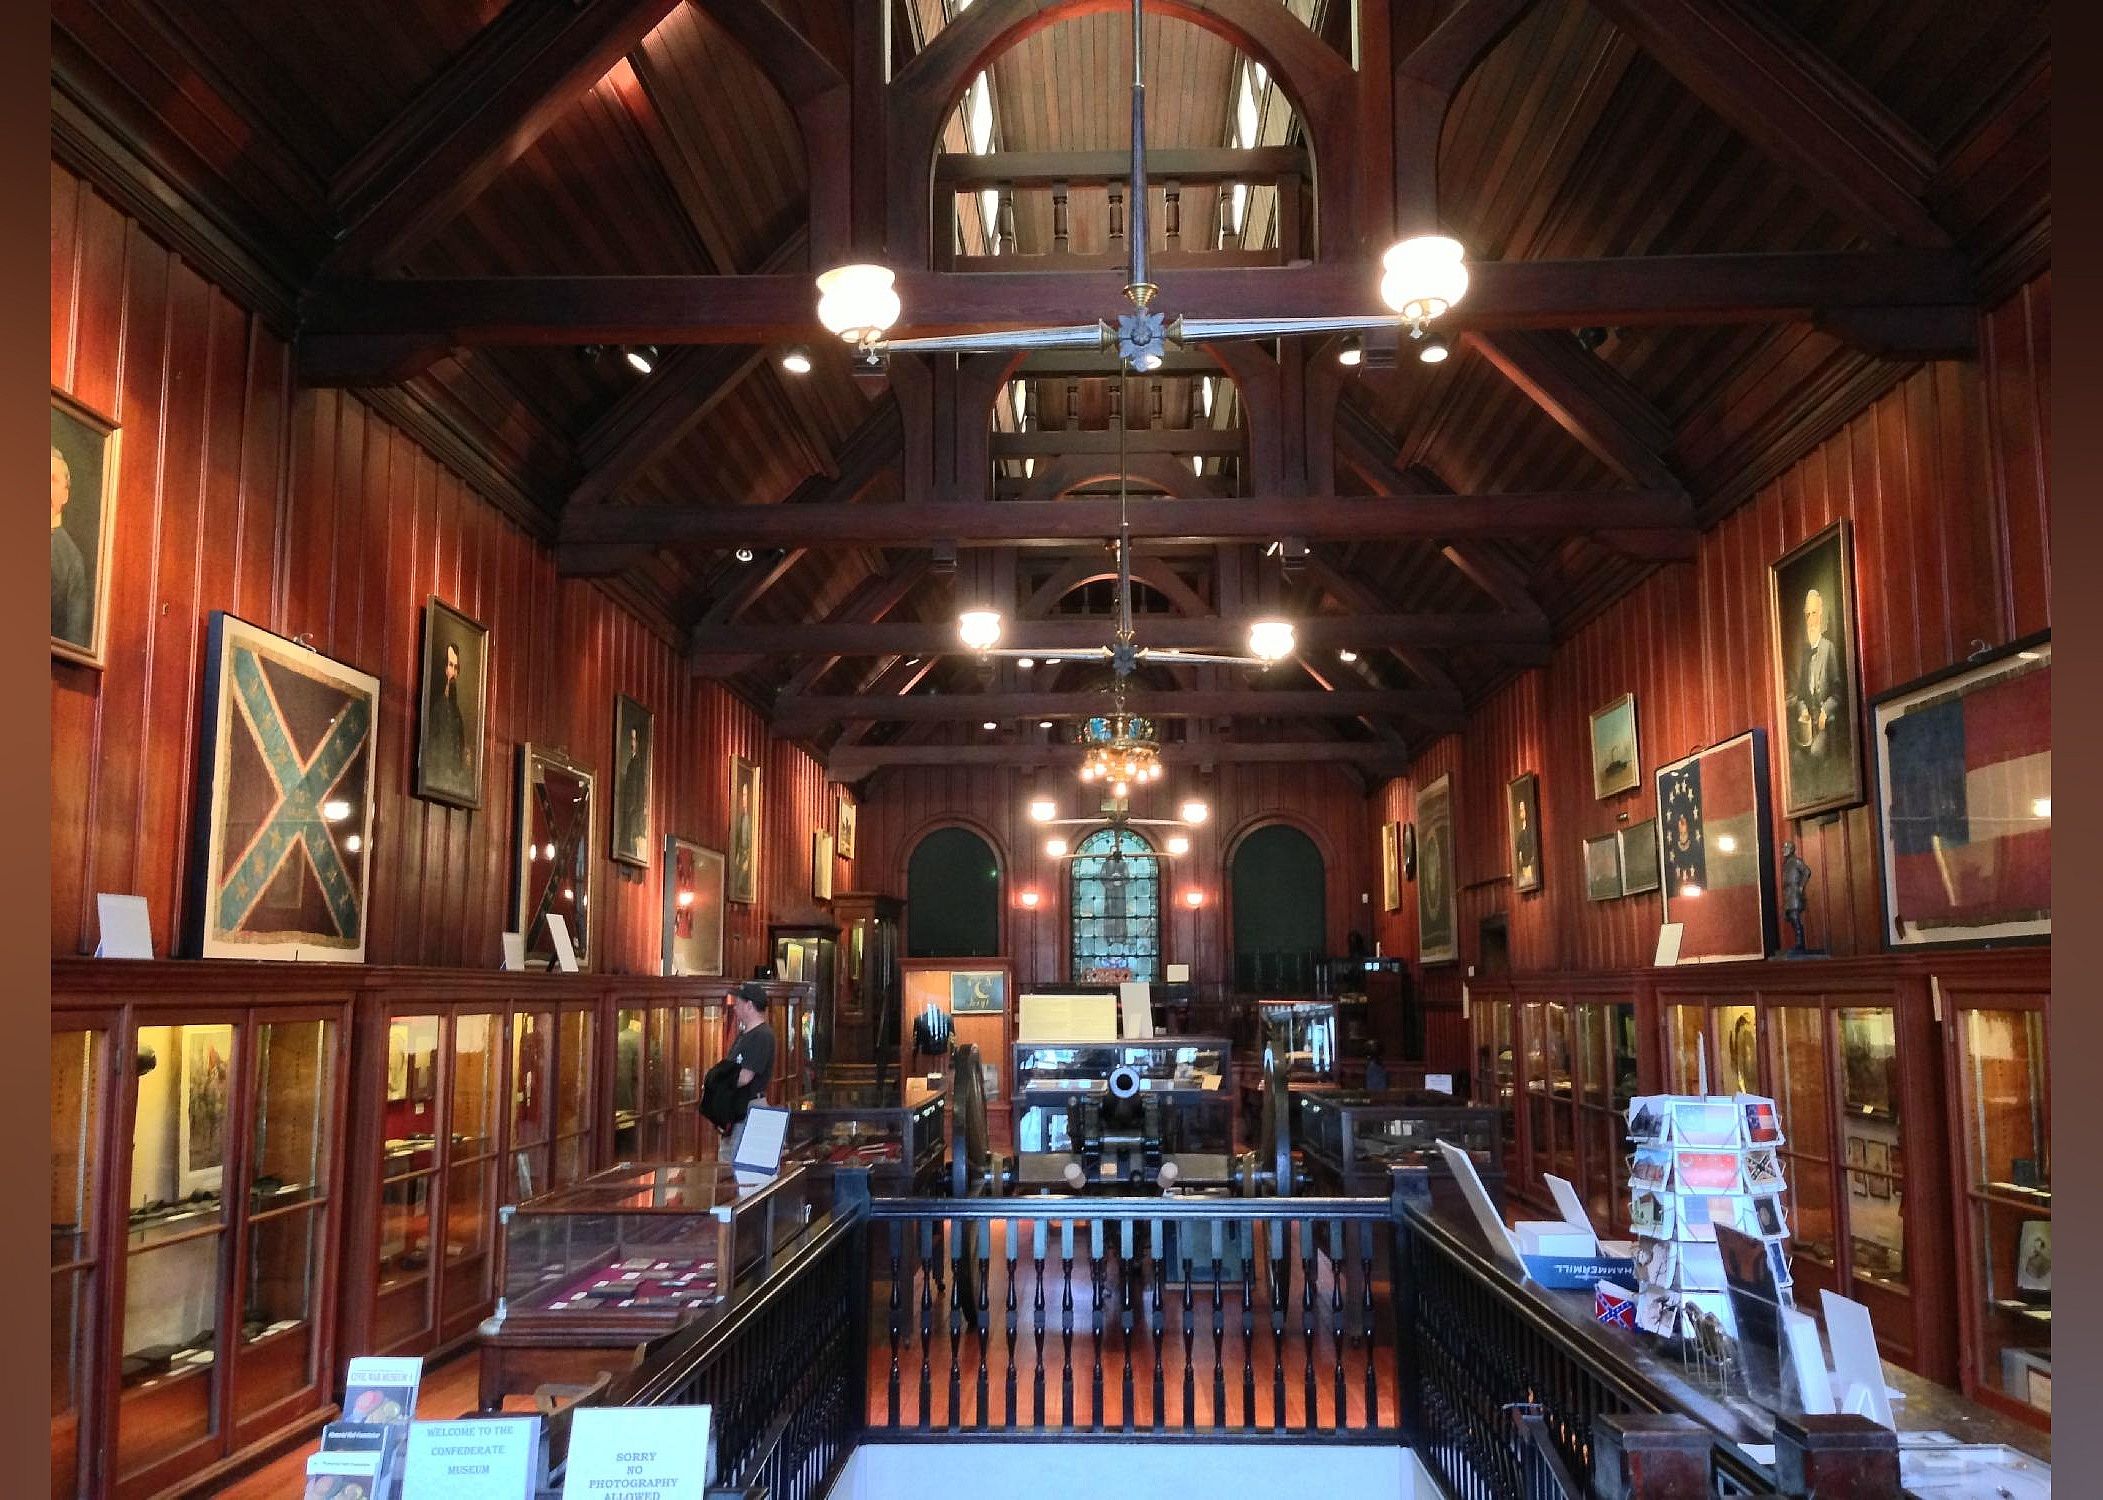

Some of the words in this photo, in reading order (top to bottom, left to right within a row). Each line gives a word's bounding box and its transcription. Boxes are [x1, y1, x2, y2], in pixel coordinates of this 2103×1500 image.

[1554, 1264, 1632, 1274] HAMMERMILL
[427, 1427, 476, 1437] WELCOME
[479, 1425, 491, 1435] TO
[495, 1425, 514, 1435] THE
[431, 1445, 505, 1456] CONFEDERATE
[616, 1452, 657, 1462] SORRY
[447, 1465, 490, 1475] MUSEUM
[626, 1465, 643, 1475] NO
[589, 1478, 679, 1488] PHOTOGRAPHY
